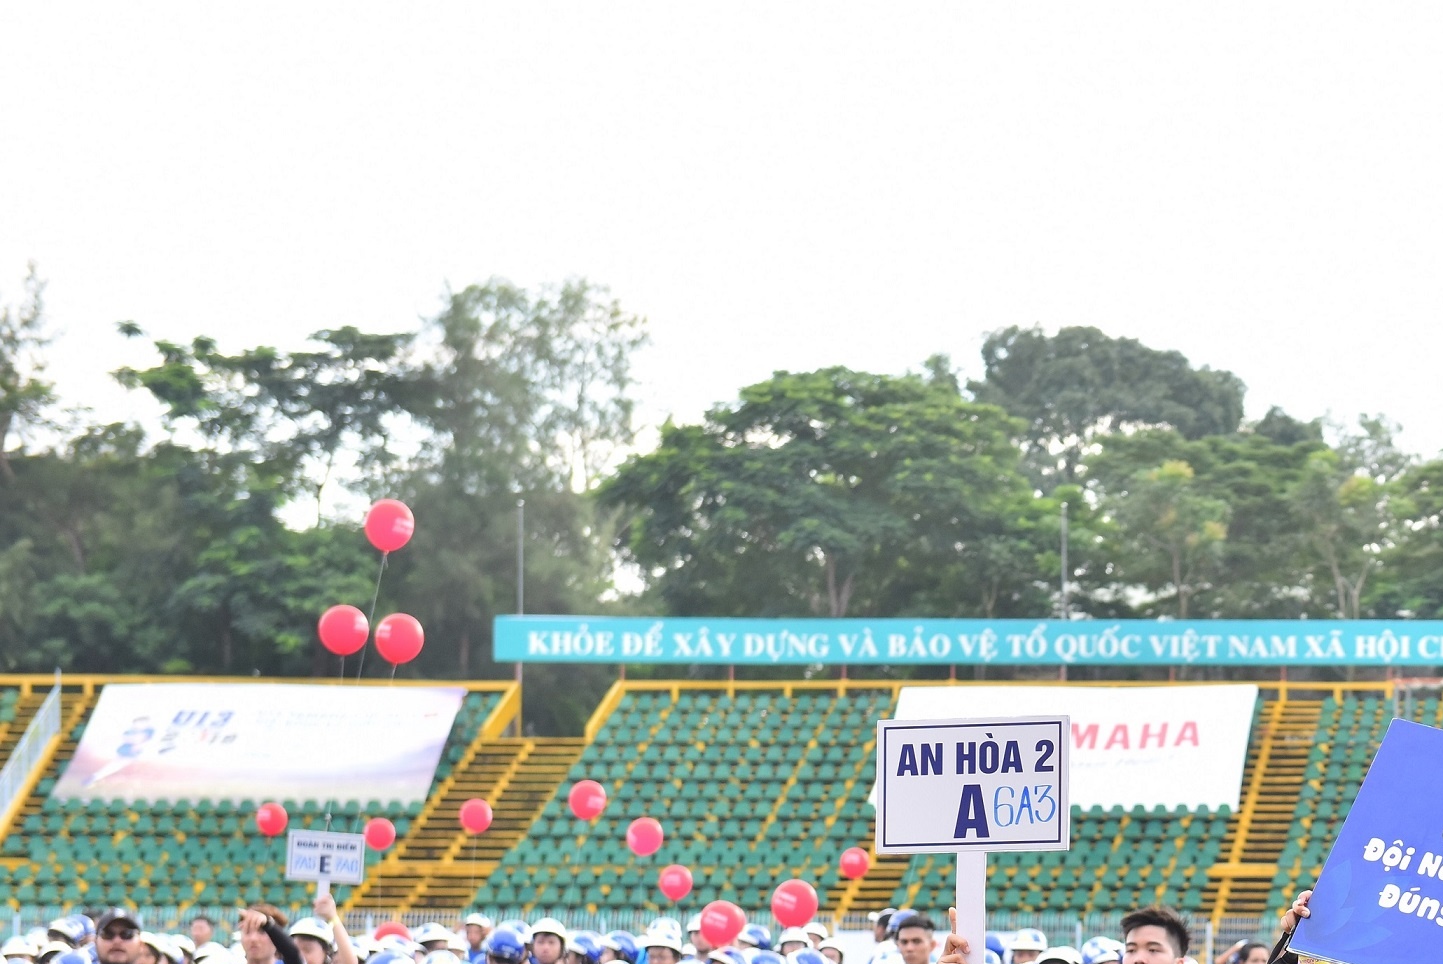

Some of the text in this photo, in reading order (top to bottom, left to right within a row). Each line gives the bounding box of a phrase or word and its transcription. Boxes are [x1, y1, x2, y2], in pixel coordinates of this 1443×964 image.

[528, 624, 615, 656] KHỎE
[621, 622, 663, 656] ĐỂ
[673, 626, 737, 657] XÂY
[743, 631, 830, 663] DỰNG
[837, 625, 879, 657] VÀ
[887, 625, 951, 657] BẢO
[958, 627, 999, 663] VỆ
[1006, 622, 1048, 658] TỔ
[1055, 625, 1142, 661] QUỐC
[1148, 629, 1222, 663] VIỆT
[1227, 634, 1299, 660] NAM
[1303, 629, 1346, 661] XÃ
[1354, 629, 1409, 663] HỘI
[897, 742, 943, 776] AN
[956, 732, 1023, 775] HÒA
[1034, 739, 1054, 772] 2
[1071, 721, 1199, 751] MAHA
[953, 784, 990, 839] A
[993, 785, 1056, 827] 6A3
[319, 855, 332, 874] E
[1363, 837, 1416, 872] Đội
